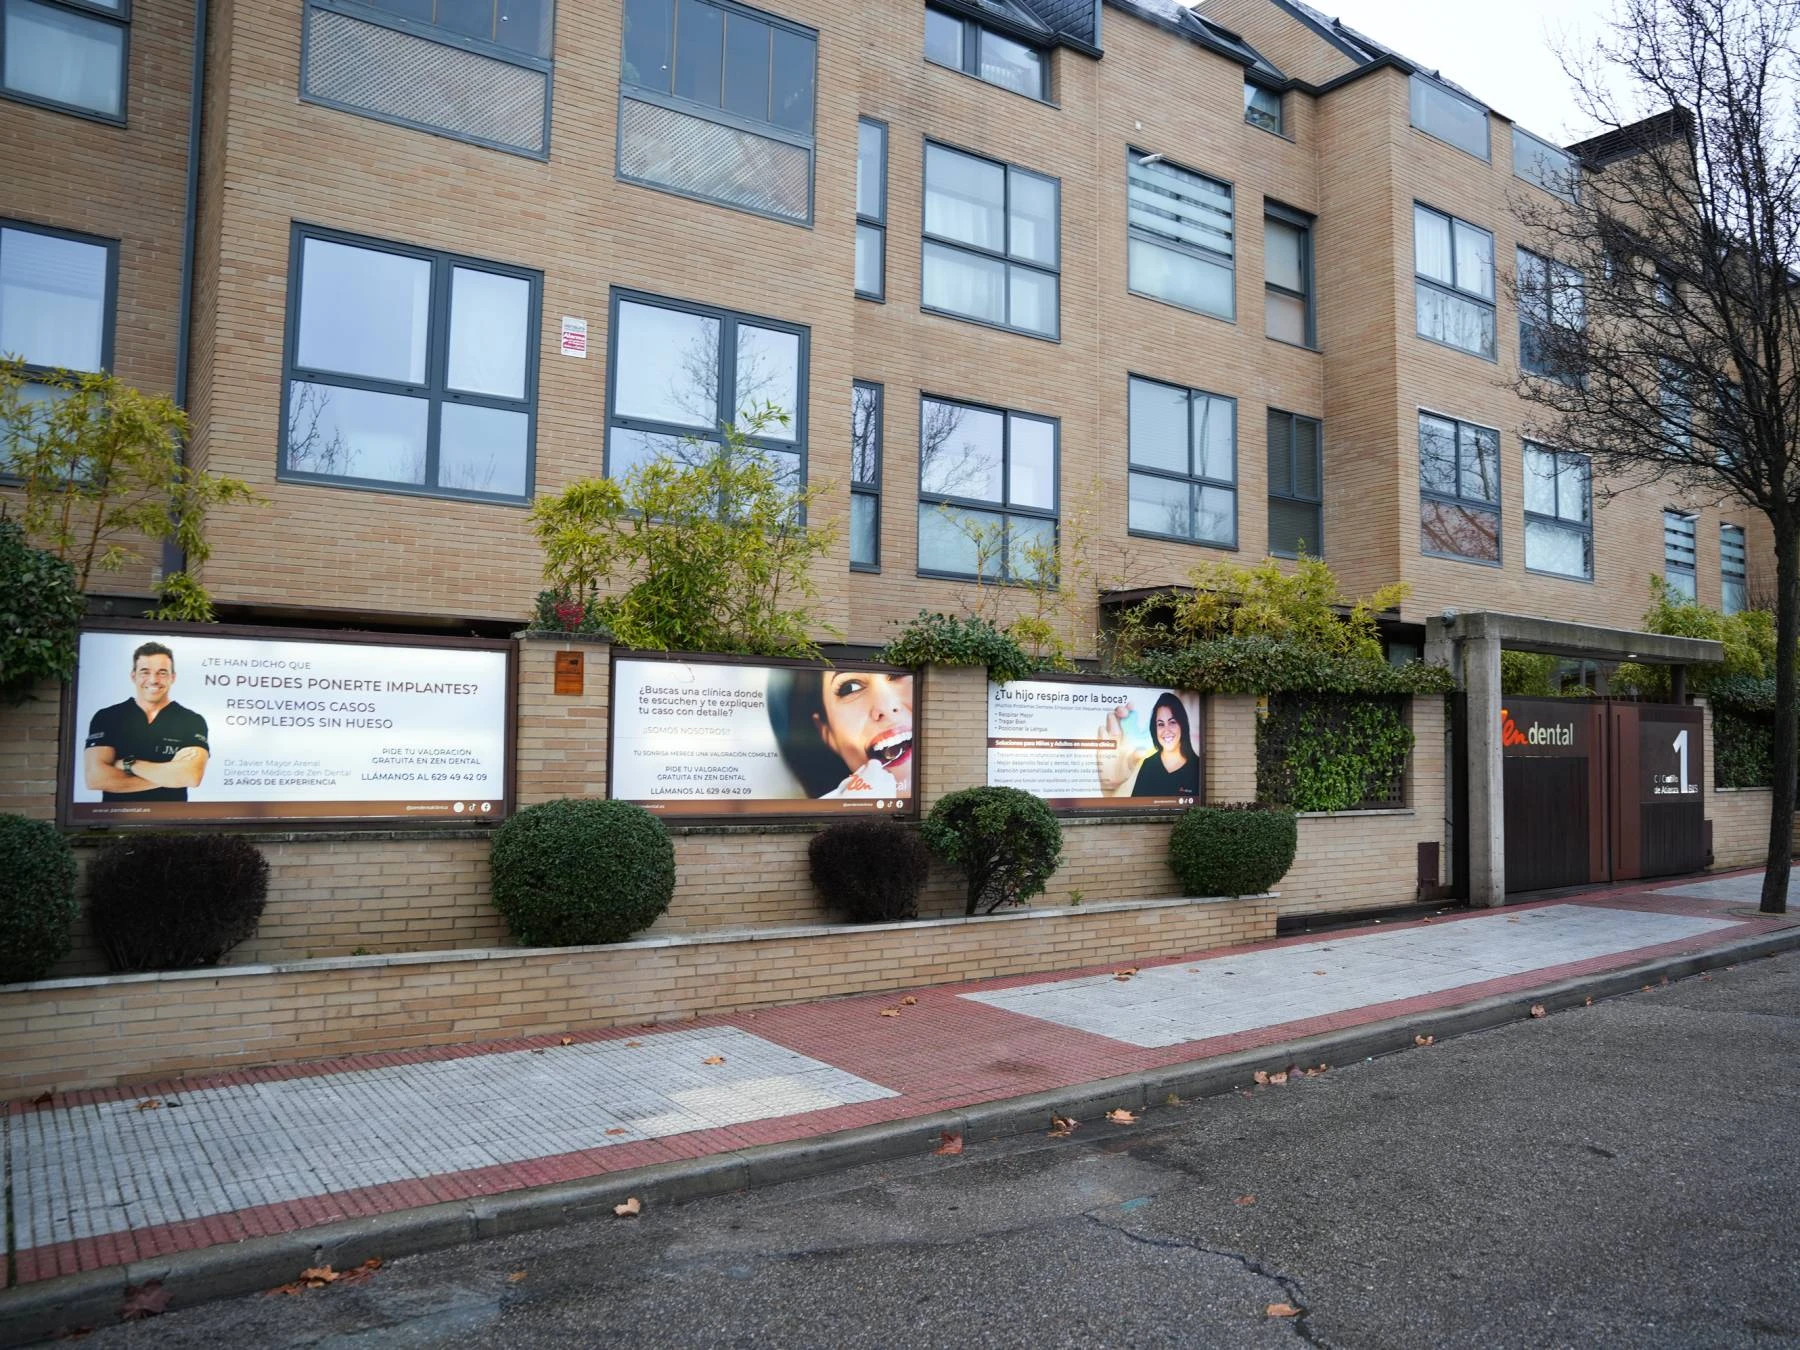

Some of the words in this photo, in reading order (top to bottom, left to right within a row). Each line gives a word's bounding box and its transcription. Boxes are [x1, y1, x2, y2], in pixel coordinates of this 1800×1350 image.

[202, 658, 220, 666] ¿TE
[224, 659, 248, 667] HAN
[251, 660, 286, 668] DICHO
[288, 662, 311, 670] QUE
[205, 675, 230, 686] NO
[236, 676, 302, 688] PUEDES
[308, 678, 382, 691] PONERTE
[387, 682, 478, 694] IMPLANTES?
[640, 686, 679, 695] ¿Buscas
[702, 688, 731, 697] clínica
[734, 690, 763, 698] donde
[995, 689, 1012, 700] ¿Tu
[1016, 690, 1033, 702] hijo
[1037, 692, 1069, 703] respira
[1073, 694, 1088, 703] por
[1091, 694, 1098, 702] la
[1101, 694, 1127, 703] boca?
[226, 699, 325, 711] RESOLVEMOS
[330, 702, 376, 712] CASOS
[652, 697, 697, 705] escuchen
[700, 699, 705, 707] y
[720, 699, 764, 709] expliquen
[697, 708, 733, 717] detalle?
[226, 716, 315, 727] COMPLEJOS
[319, 718, 341, 728] SIN
[346, 718, 392, 728] HUESO
[1529, 721, 1573, 745] dental
[266, 760, 291, 768] Mayor
[1673, 730, 1688, 793] 1
[236, 777, 261, 785] AÑOS
